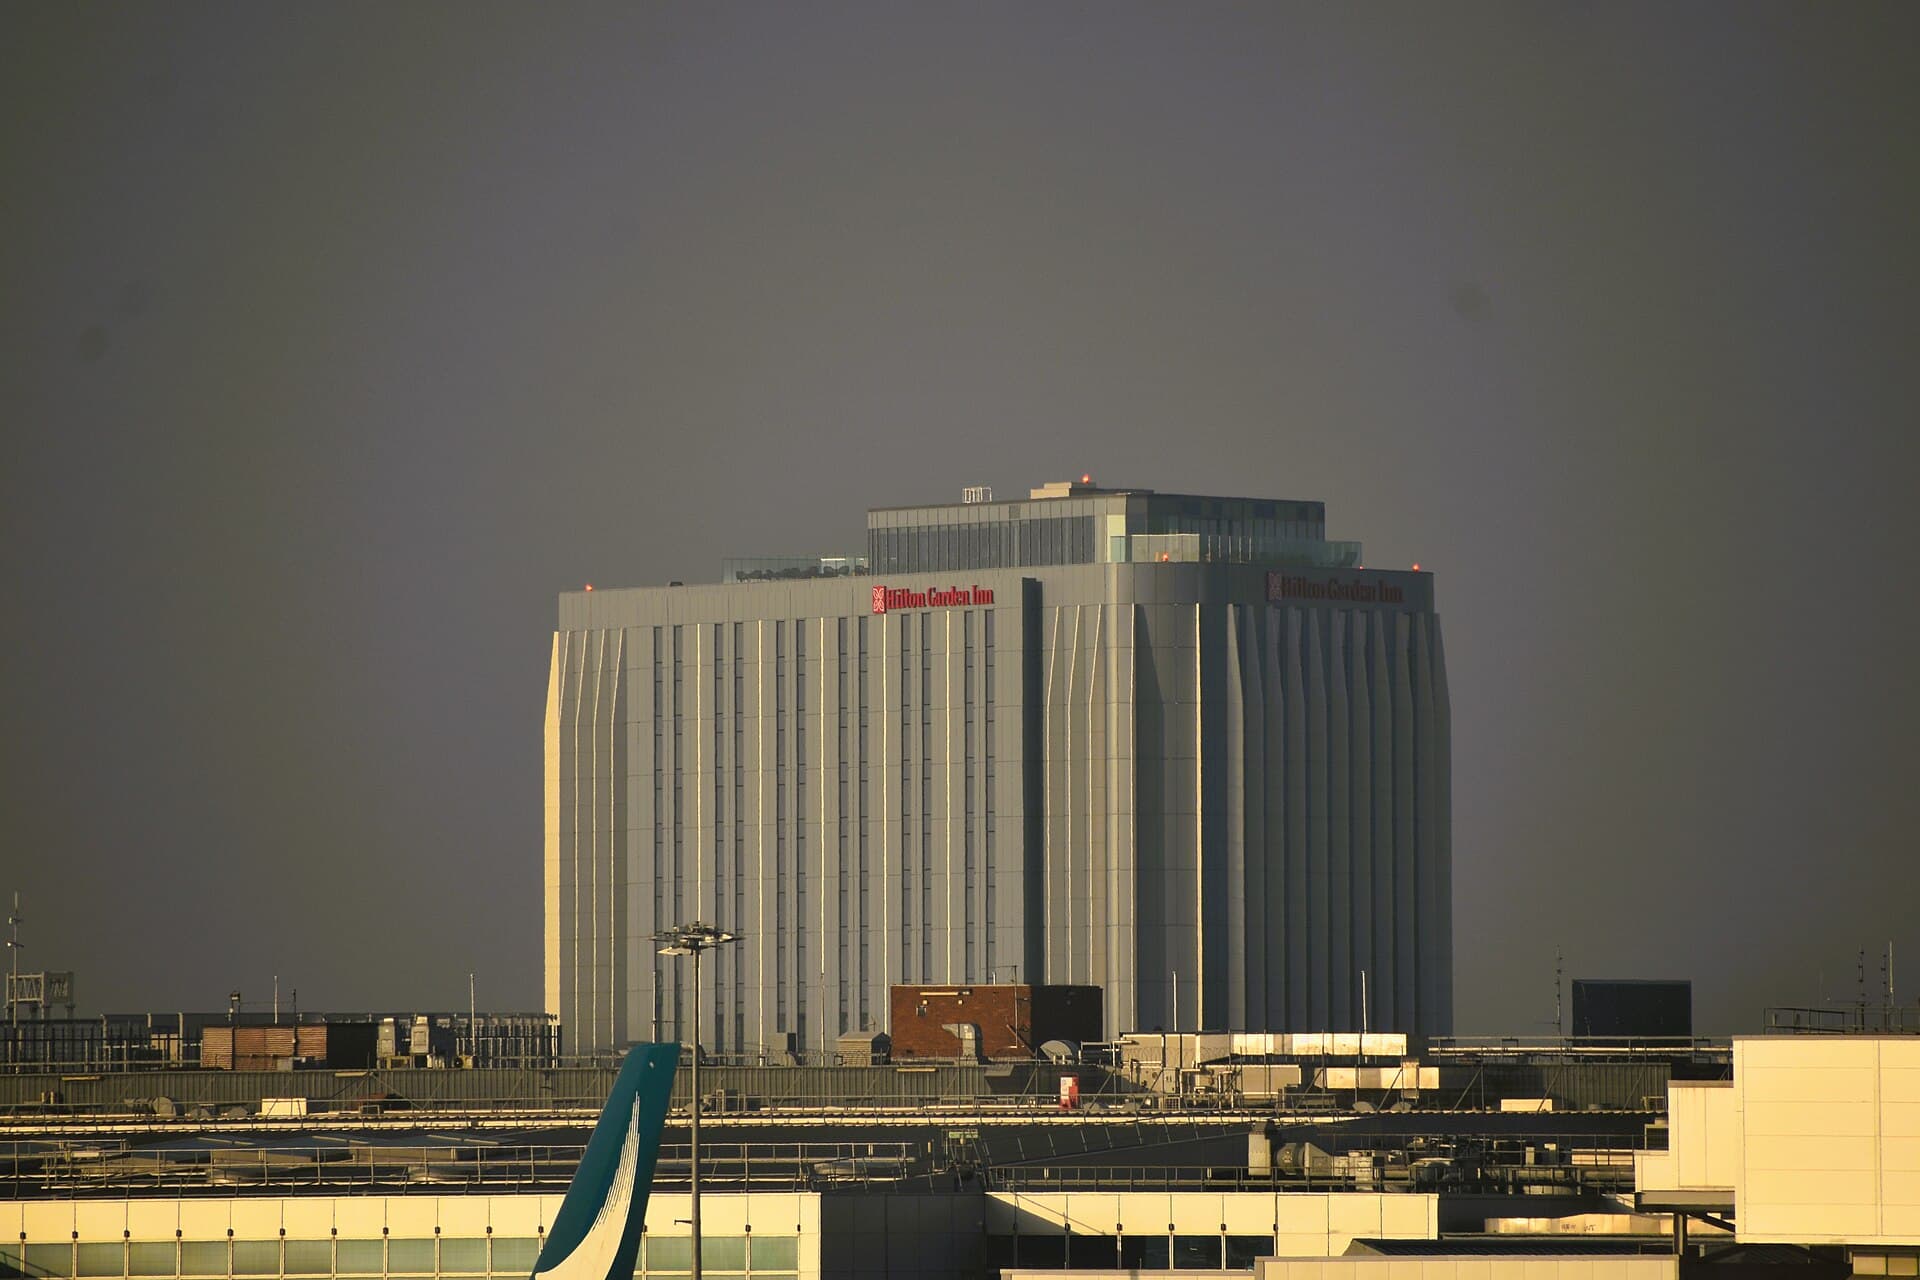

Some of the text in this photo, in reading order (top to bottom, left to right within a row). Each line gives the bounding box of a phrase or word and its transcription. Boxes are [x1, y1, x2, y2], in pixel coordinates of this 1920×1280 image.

[887, 585, 994, 609] Hilton Garden Inn
[1281, 576, 1403, 603] Hilton Garden Inn
